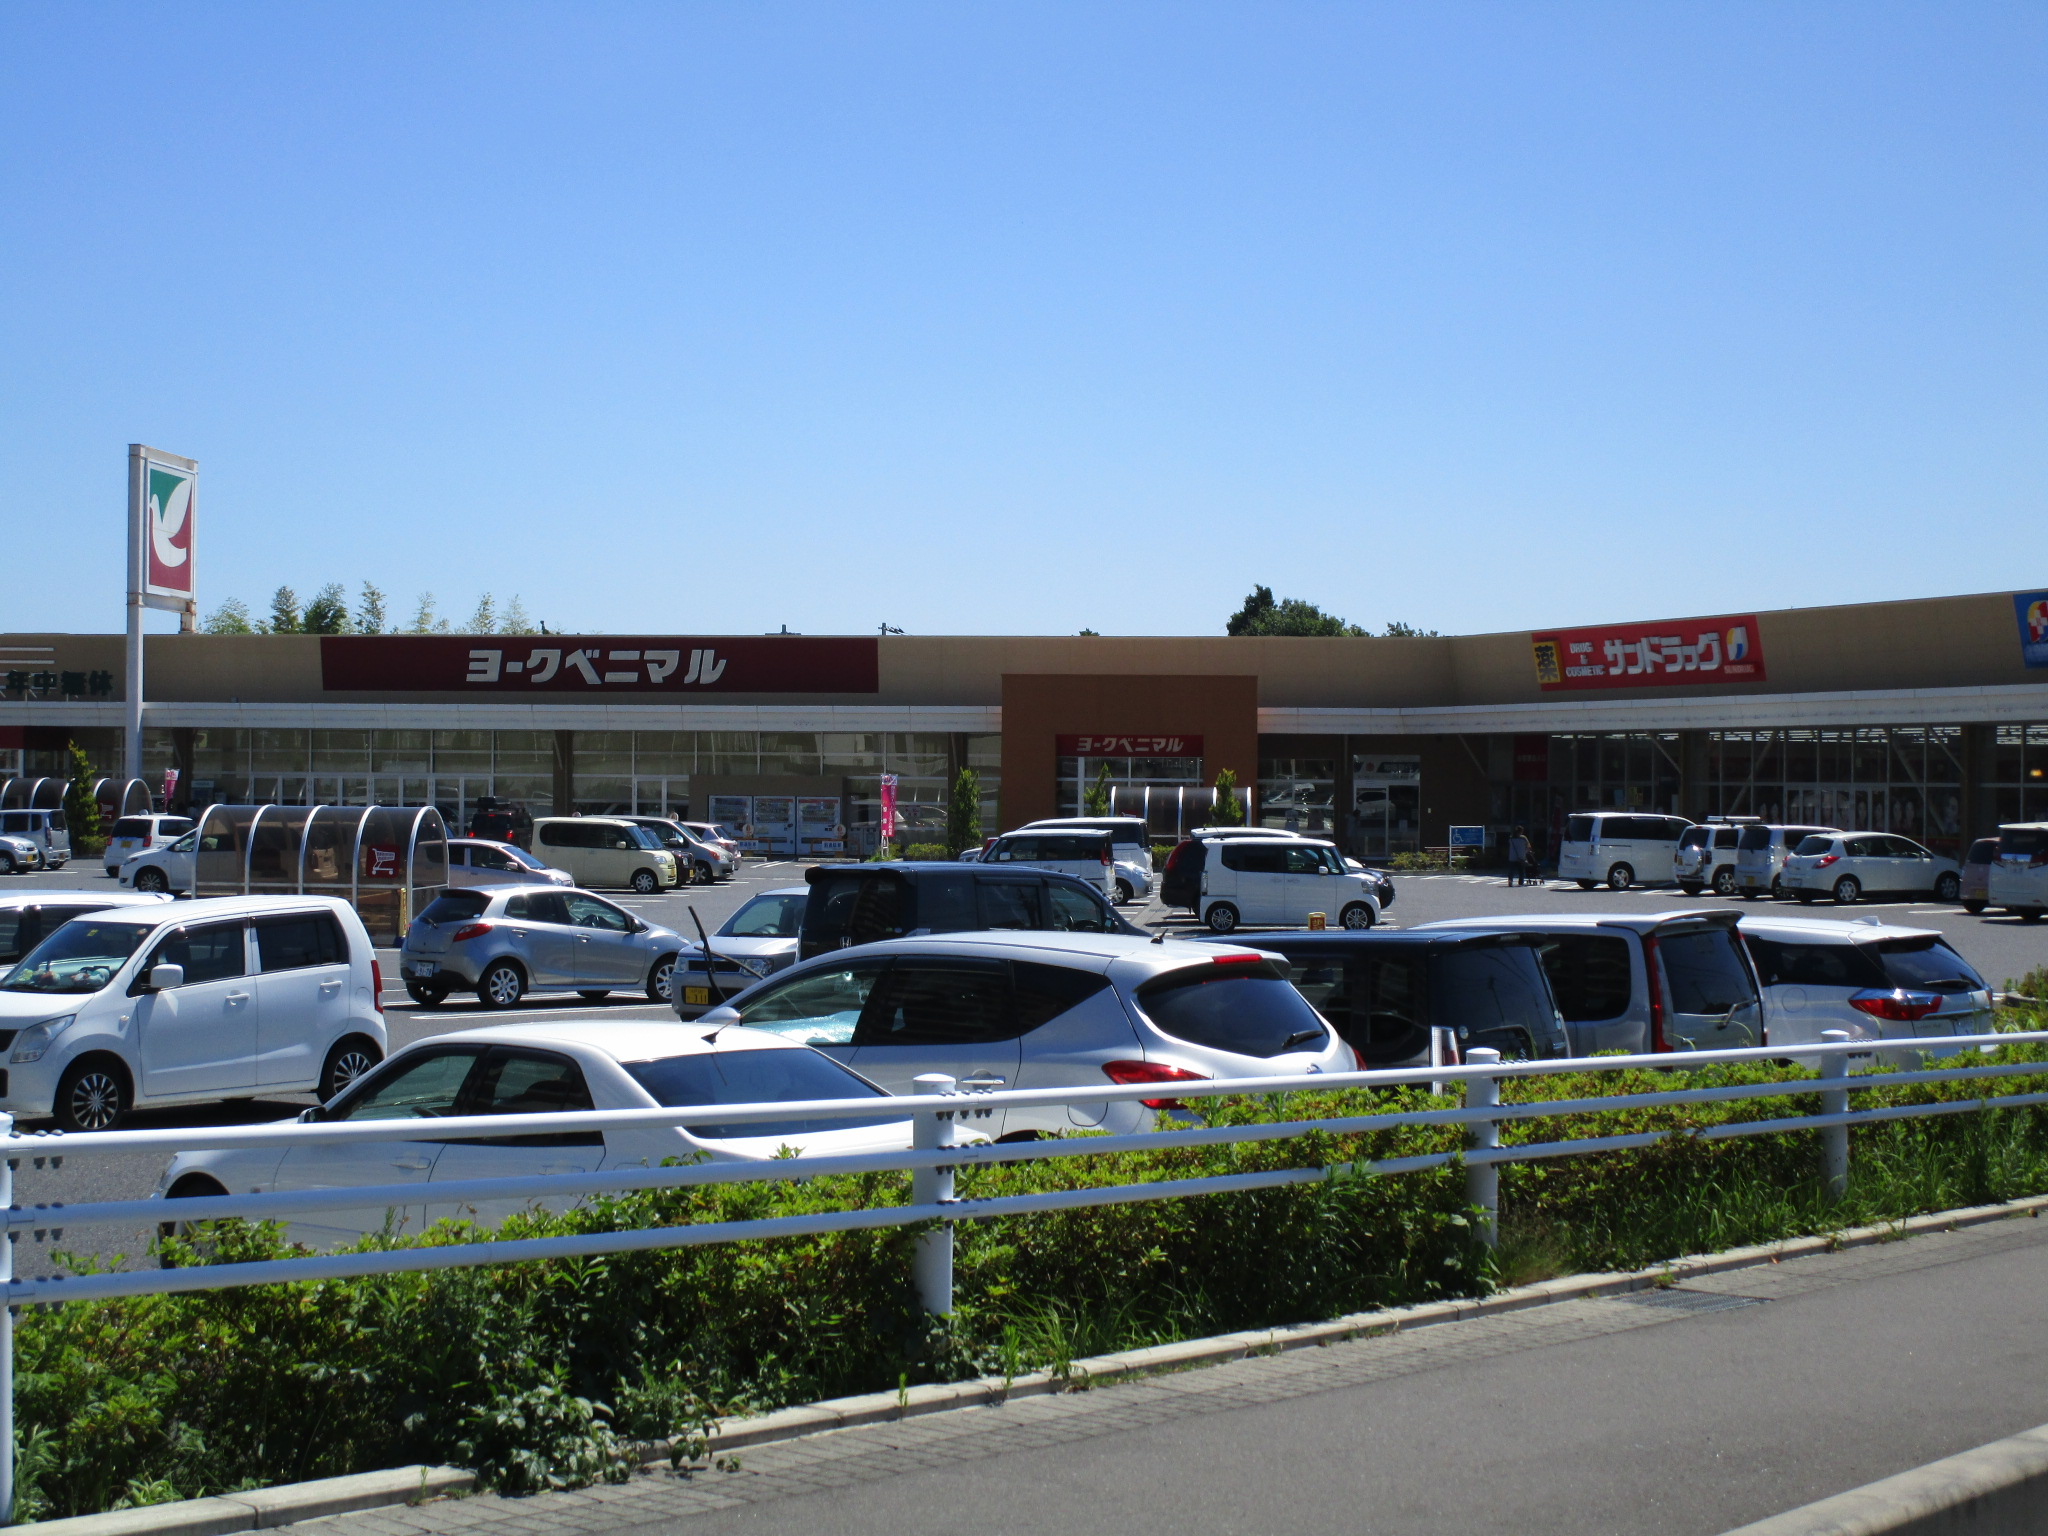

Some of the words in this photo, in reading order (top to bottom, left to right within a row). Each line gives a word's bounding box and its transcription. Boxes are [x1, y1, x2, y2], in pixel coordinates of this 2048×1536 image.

[1569, 642, 1594, 654] DRUG
[1603, 632, 1722, 676] サンドラッグ
[466, 648, 727, 685] ヨークベニマル
[1535, 645, 1559, 681] 薬
[1565, 665, 1606, 677] COSMETIC
[1077, 737, 1184, 753] ヨークベニマル
